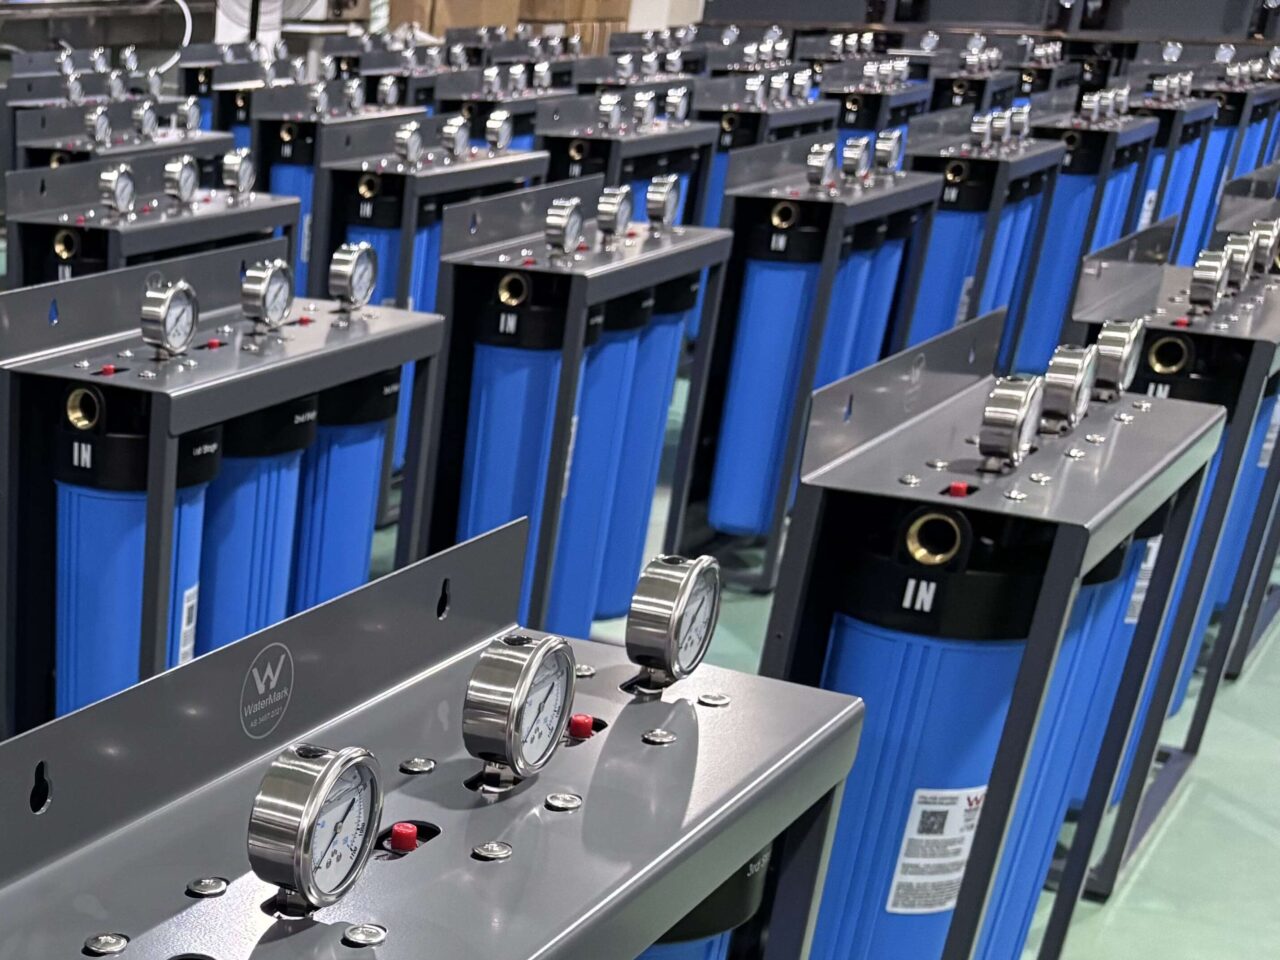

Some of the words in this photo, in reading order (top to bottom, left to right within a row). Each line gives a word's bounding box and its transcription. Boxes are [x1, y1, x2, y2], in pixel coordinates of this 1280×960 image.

[73, 441, 92, 469] IN
[901, 577, 938, 613] IN
[251, 653, 286, 695] W
